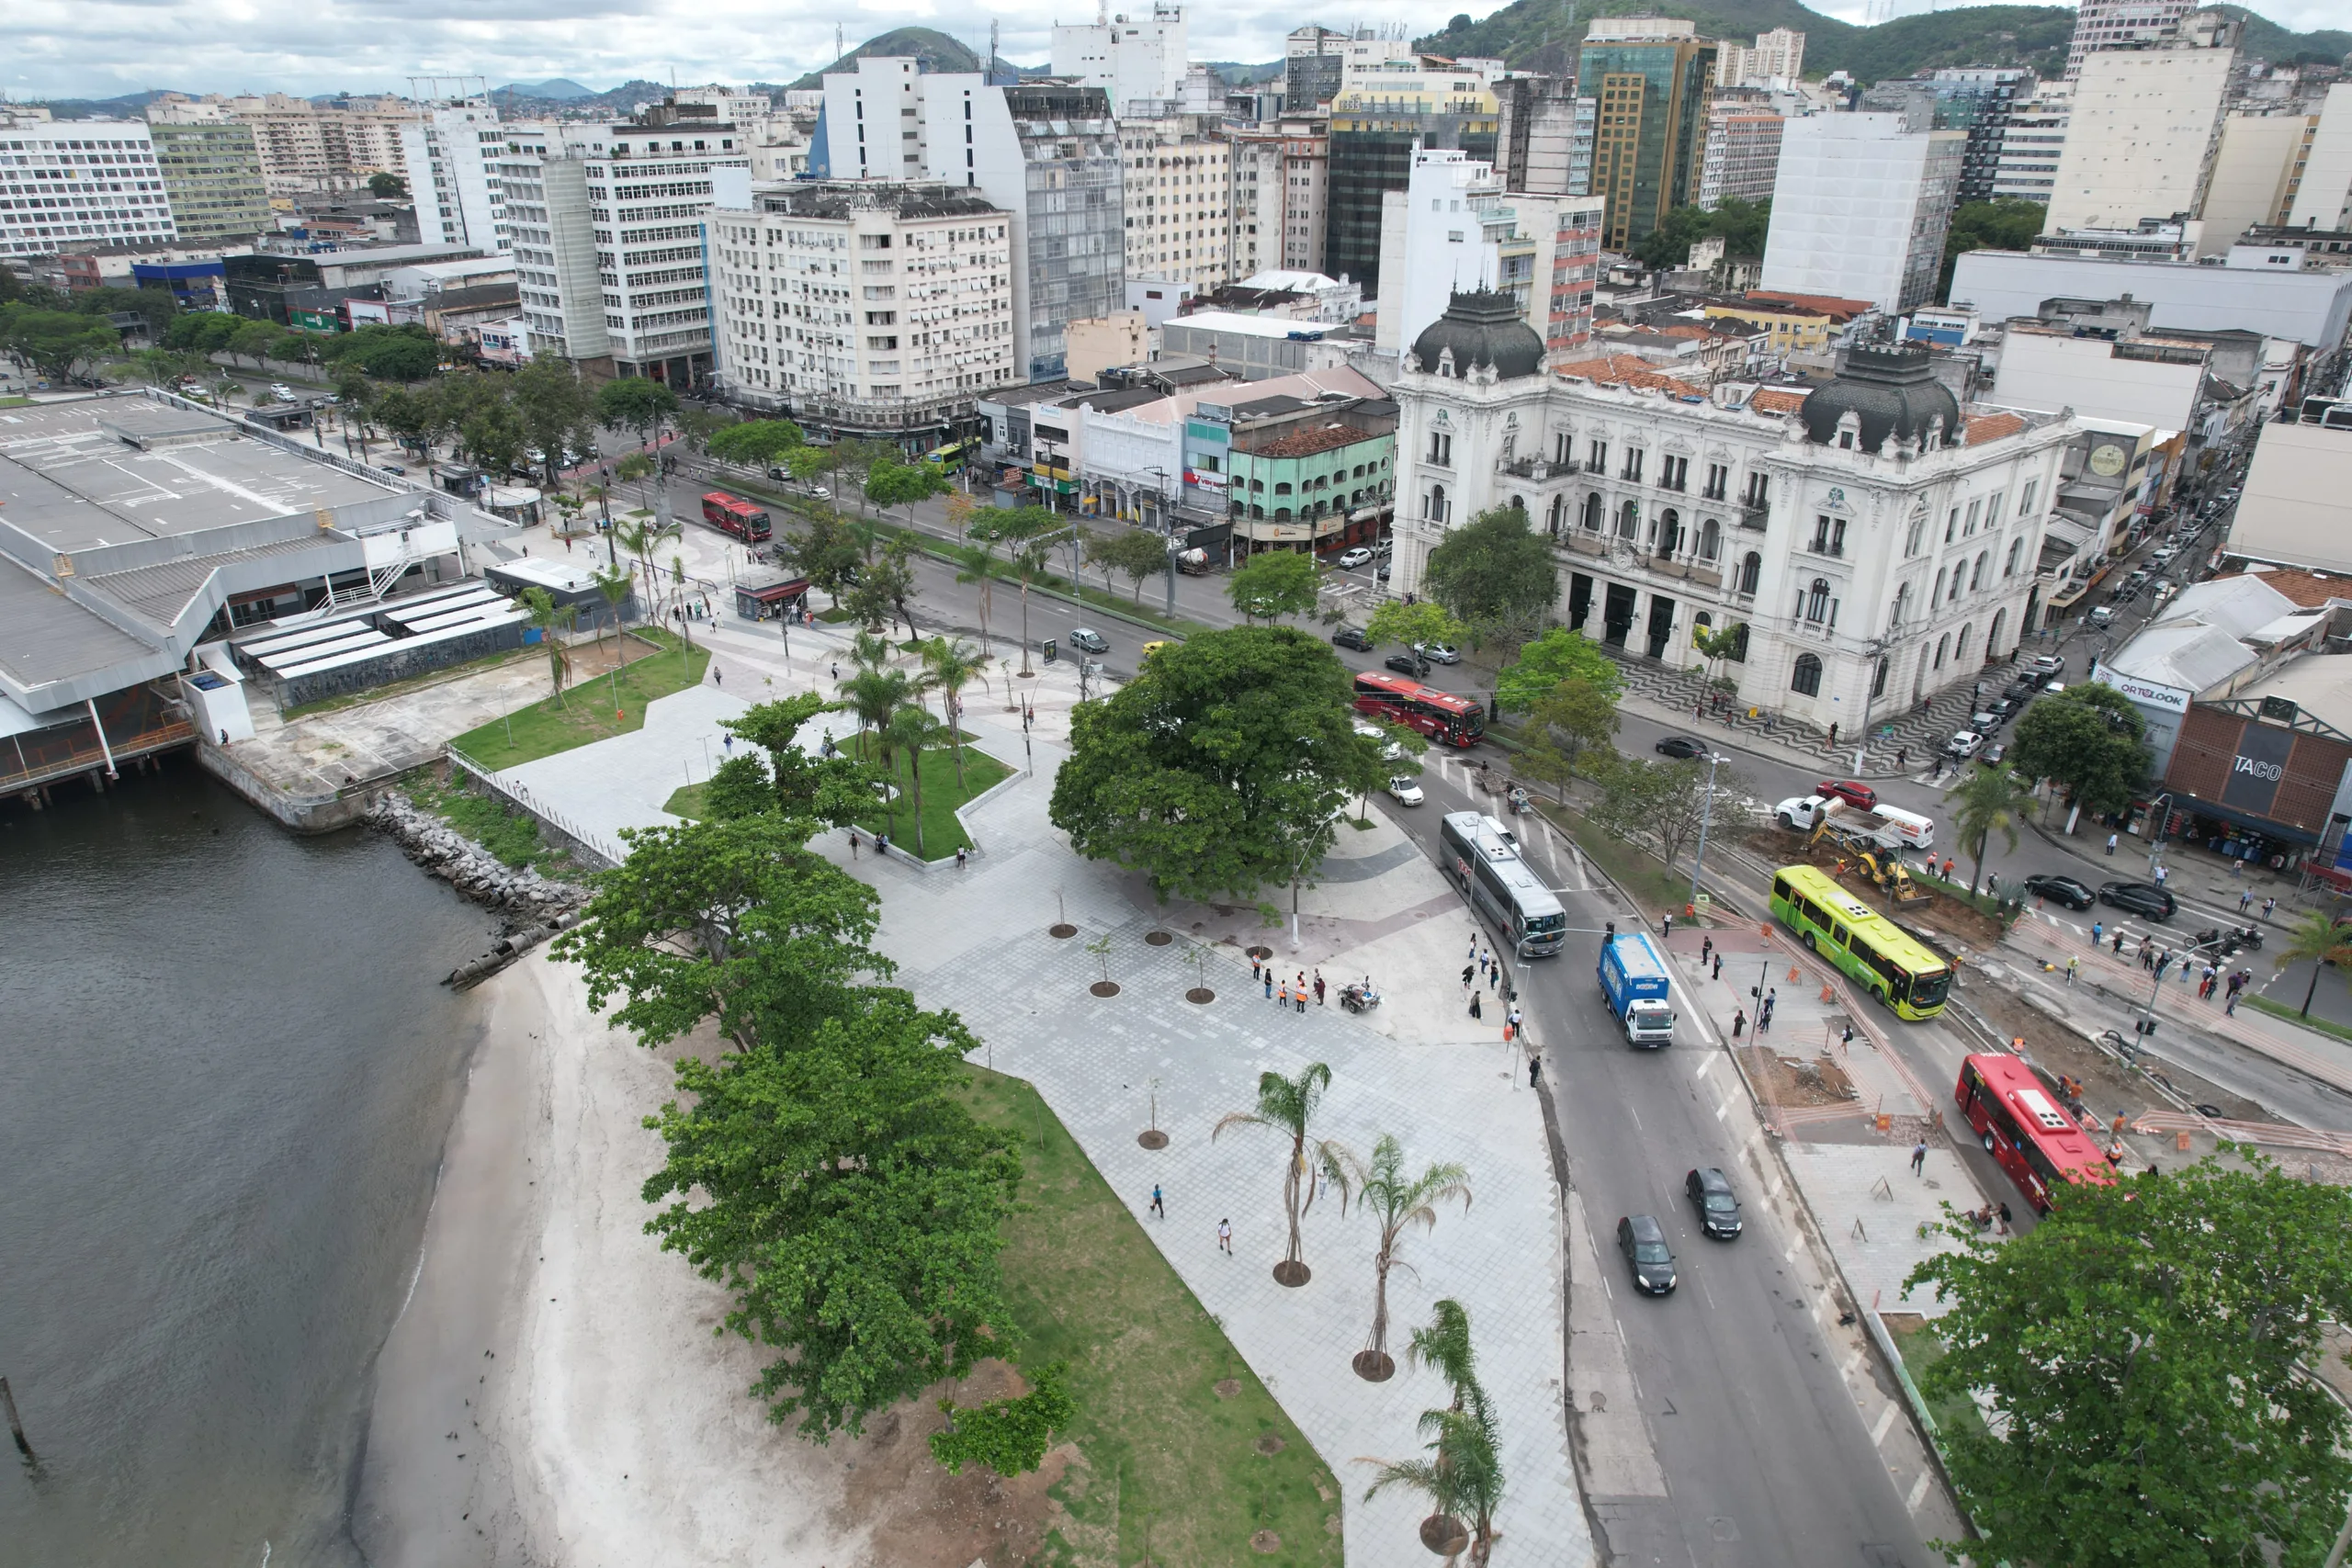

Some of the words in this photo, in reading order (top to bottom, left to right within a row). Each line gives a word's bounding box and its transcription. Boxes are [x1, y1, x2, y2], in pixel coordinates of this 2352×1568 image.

[2121, 683, 2183, 705] ORTOLOOK
[2235, 755, 2282, 782] TACO
[1457, 857, 1473, 883] 1001
